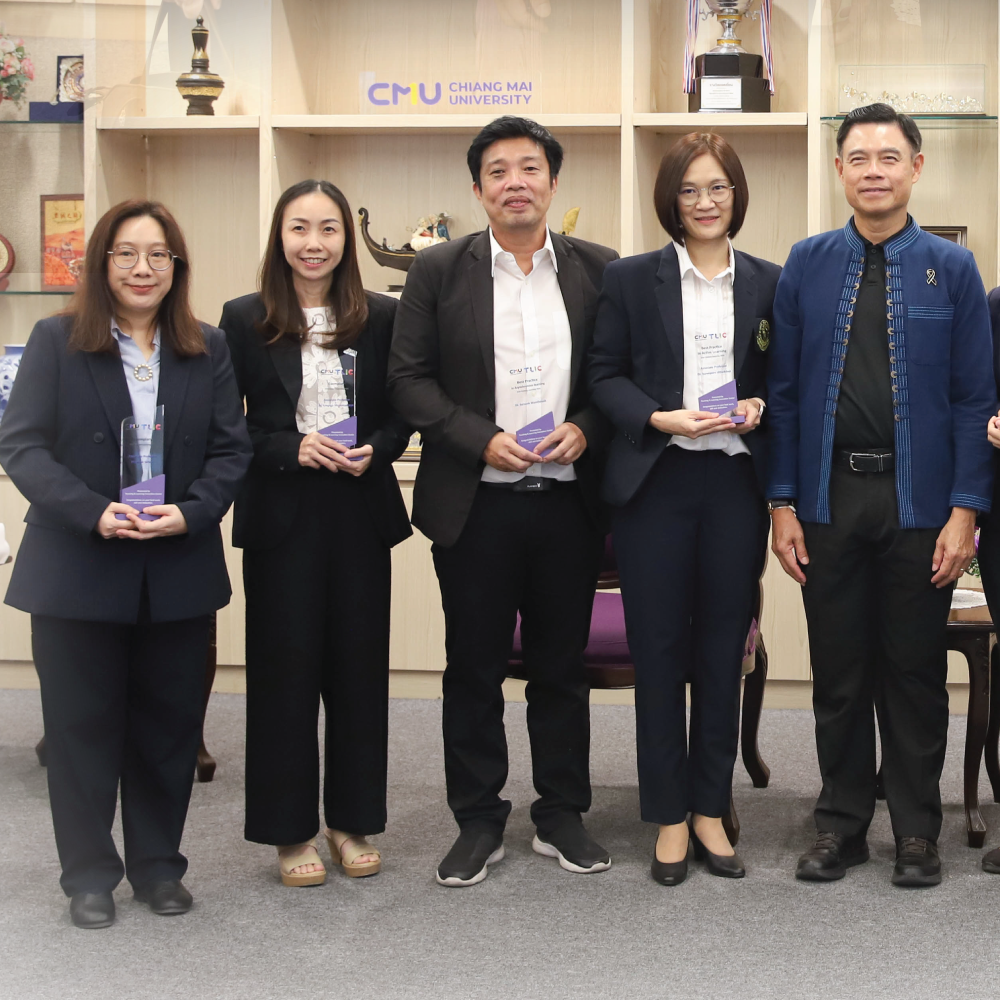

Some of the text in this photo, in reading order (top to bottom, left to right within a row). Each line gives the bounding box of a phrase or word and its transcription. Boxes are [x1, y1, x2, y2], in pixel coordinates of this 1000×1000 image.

[450, 82, 532, 92] CHIANG MAI
[368, 82, 442, 106] CMU
[450, 95, 532, 105] UNIVERSITY
